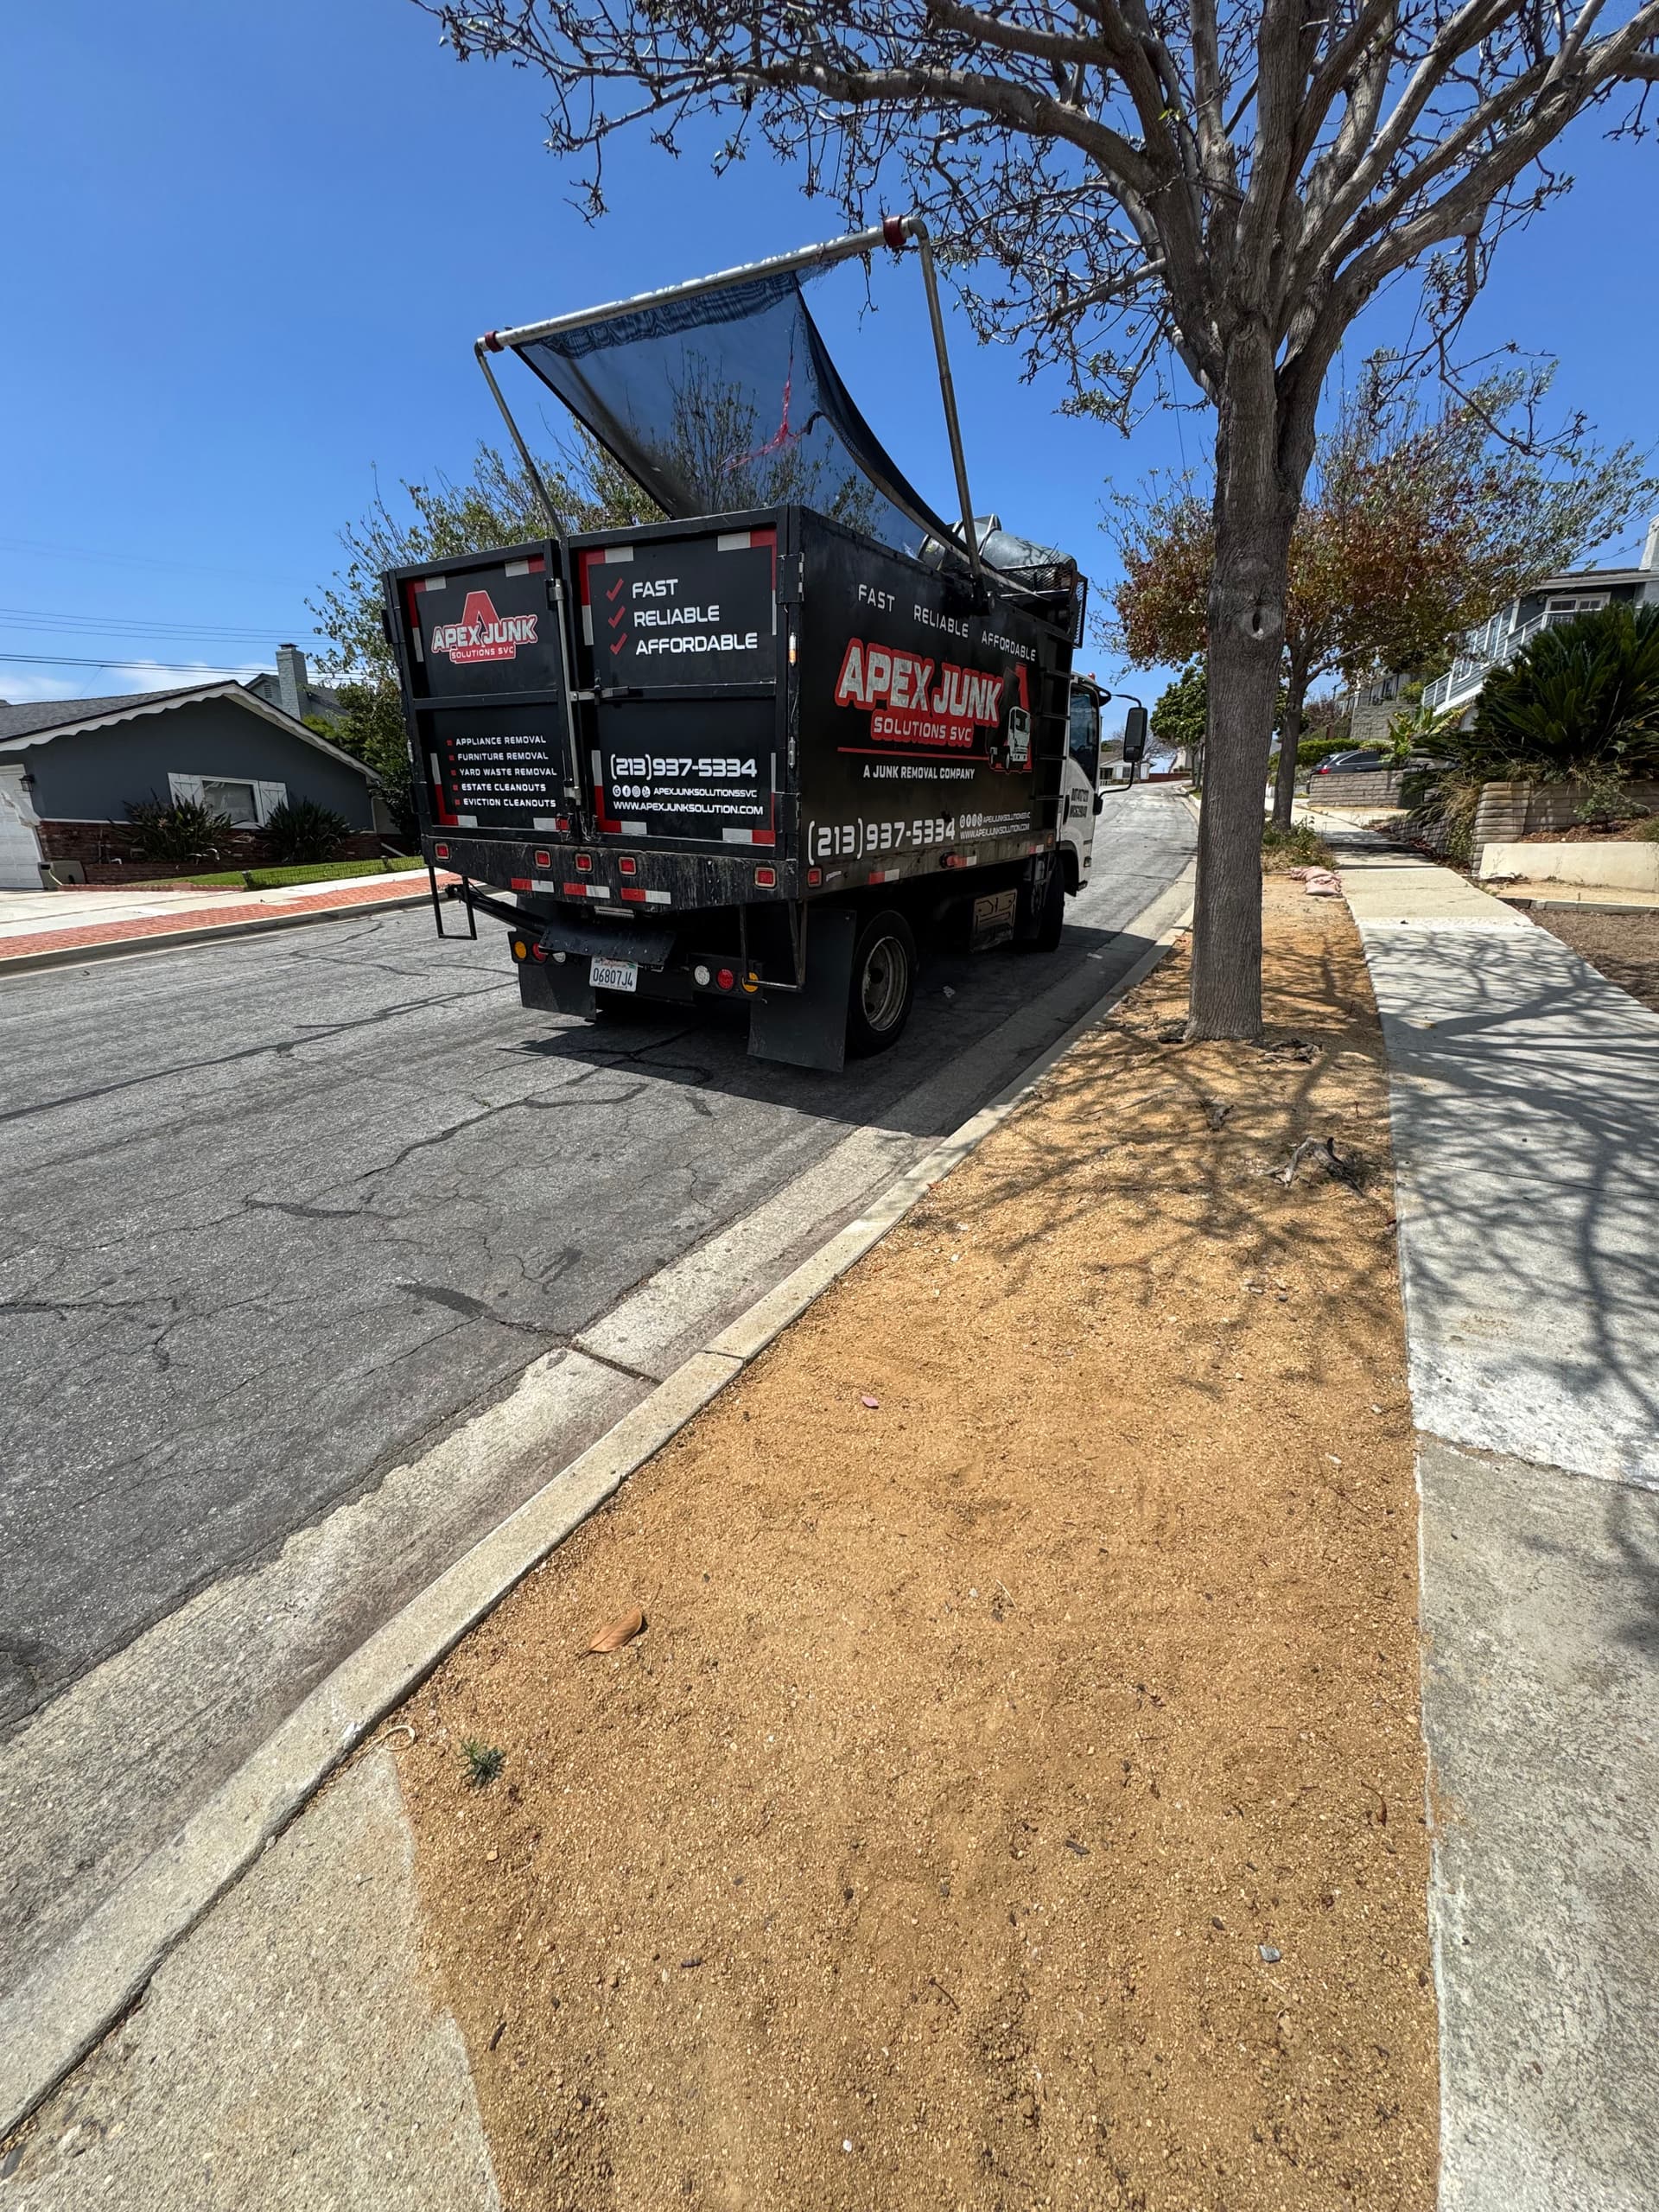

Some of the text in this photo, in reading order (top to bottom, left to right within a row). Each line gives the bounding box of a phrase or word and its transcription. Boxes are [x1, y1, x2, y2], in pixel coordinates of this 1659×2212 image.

[632, 579, 678, 599] FAST
[858, 584, 895, 613] FAST
[633, 605, 720, 627] RELIABLE
[913, 605, 969, 638] RELIABLE
[433, 618, 536, 650] APEX JUNK
[636, 632, 758, 655] AFFORDABLE
[451, 646, 514, 659] SOLUTIONS SVC
[981, 631, 1036, 661] AFFORDABLE
[838, 646, 1002, 722] APEX JUNK
[874, 716, 972, 741] SOLUTIONS SVC
[455, 735, 546, 746] APPLIANCE REMOVAL
[514, 767, 557, 776] REMOVAL
[610, 753, 758, 780] (213)937-5334
[863, 765, 975, 779] A JUNK REMOVAL COMPANY
[503, 798, 556, 807] CLEANOUTS
[653, 787, 757, 798] APEXJUNKSOLUTIONSSVC
[613, 801, 763, 815] WWW.APEXJUNKSOLUTION.COM
[808, 817, 956, 866] (213)937-5334
[593, 968, 632, 987] 06807J4
